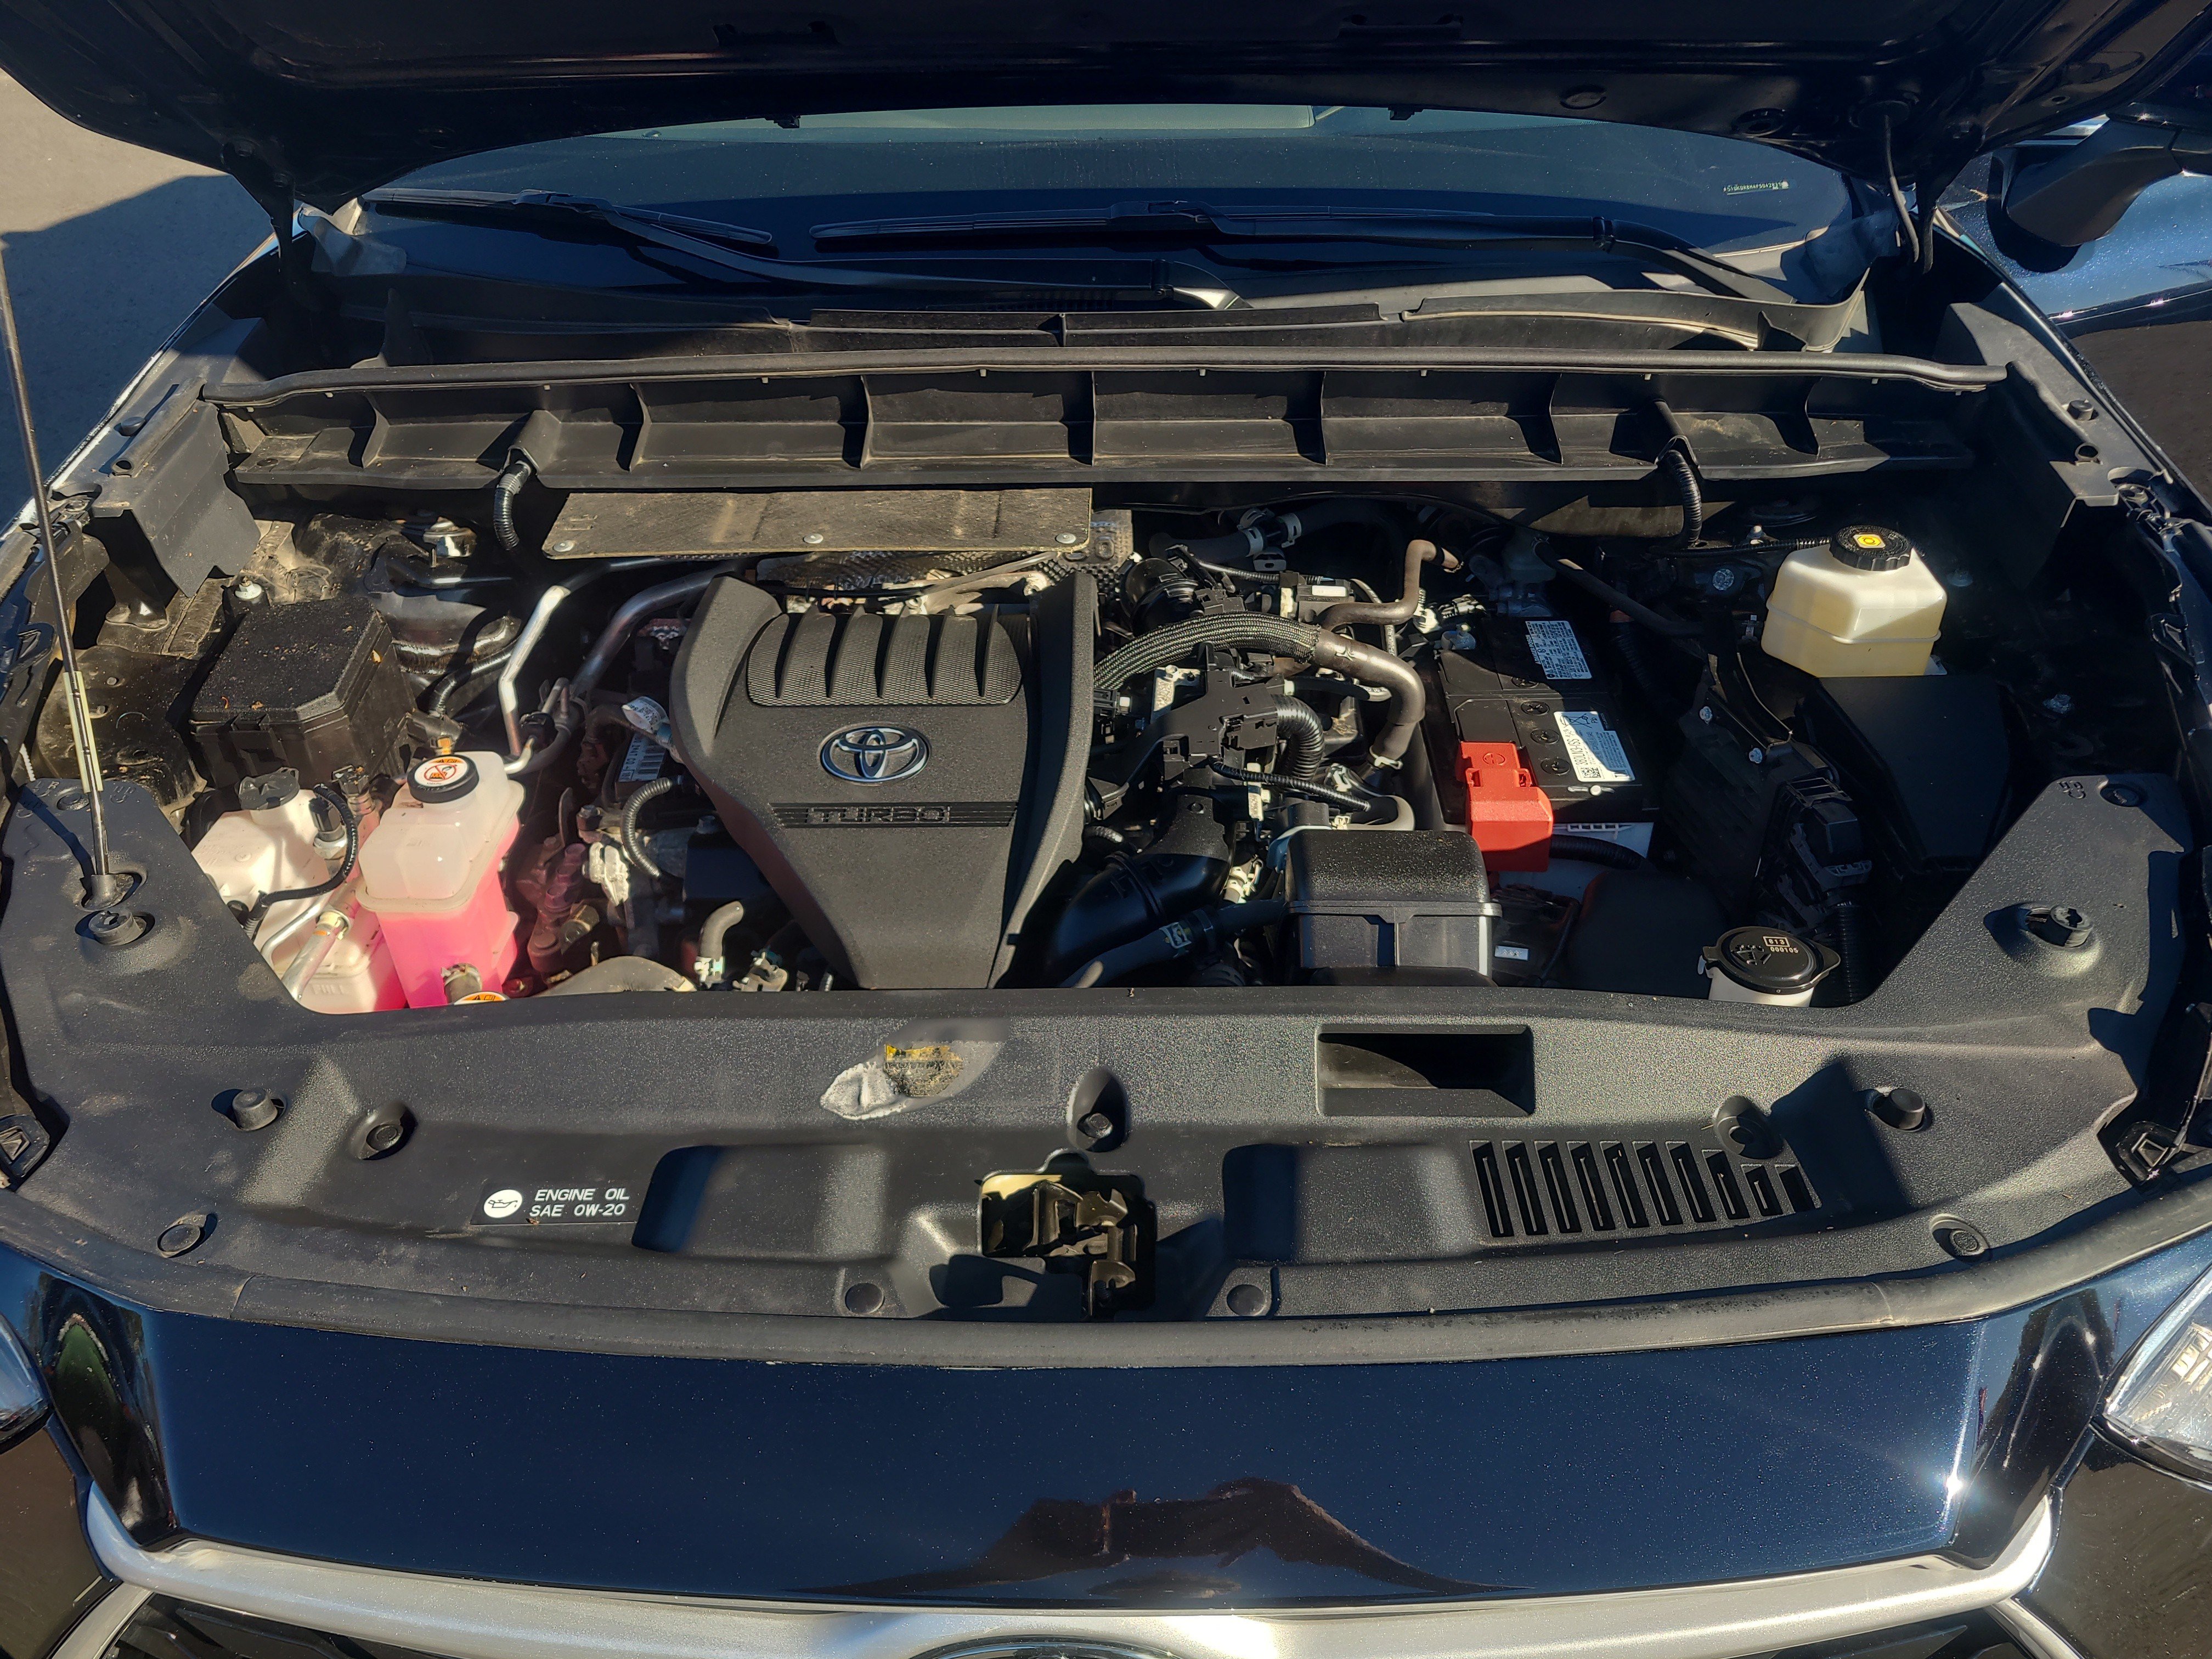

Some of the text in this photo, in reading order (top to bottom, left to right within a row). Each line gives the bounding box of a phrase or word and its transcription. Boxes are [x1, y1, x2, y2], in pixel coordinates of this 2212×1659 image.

[805, 806, 950, 822] TURBO
[534, 1188, 630, 1201] ENGINE OIL
[529, 1204, 625, 1217] SAE 0W-20
